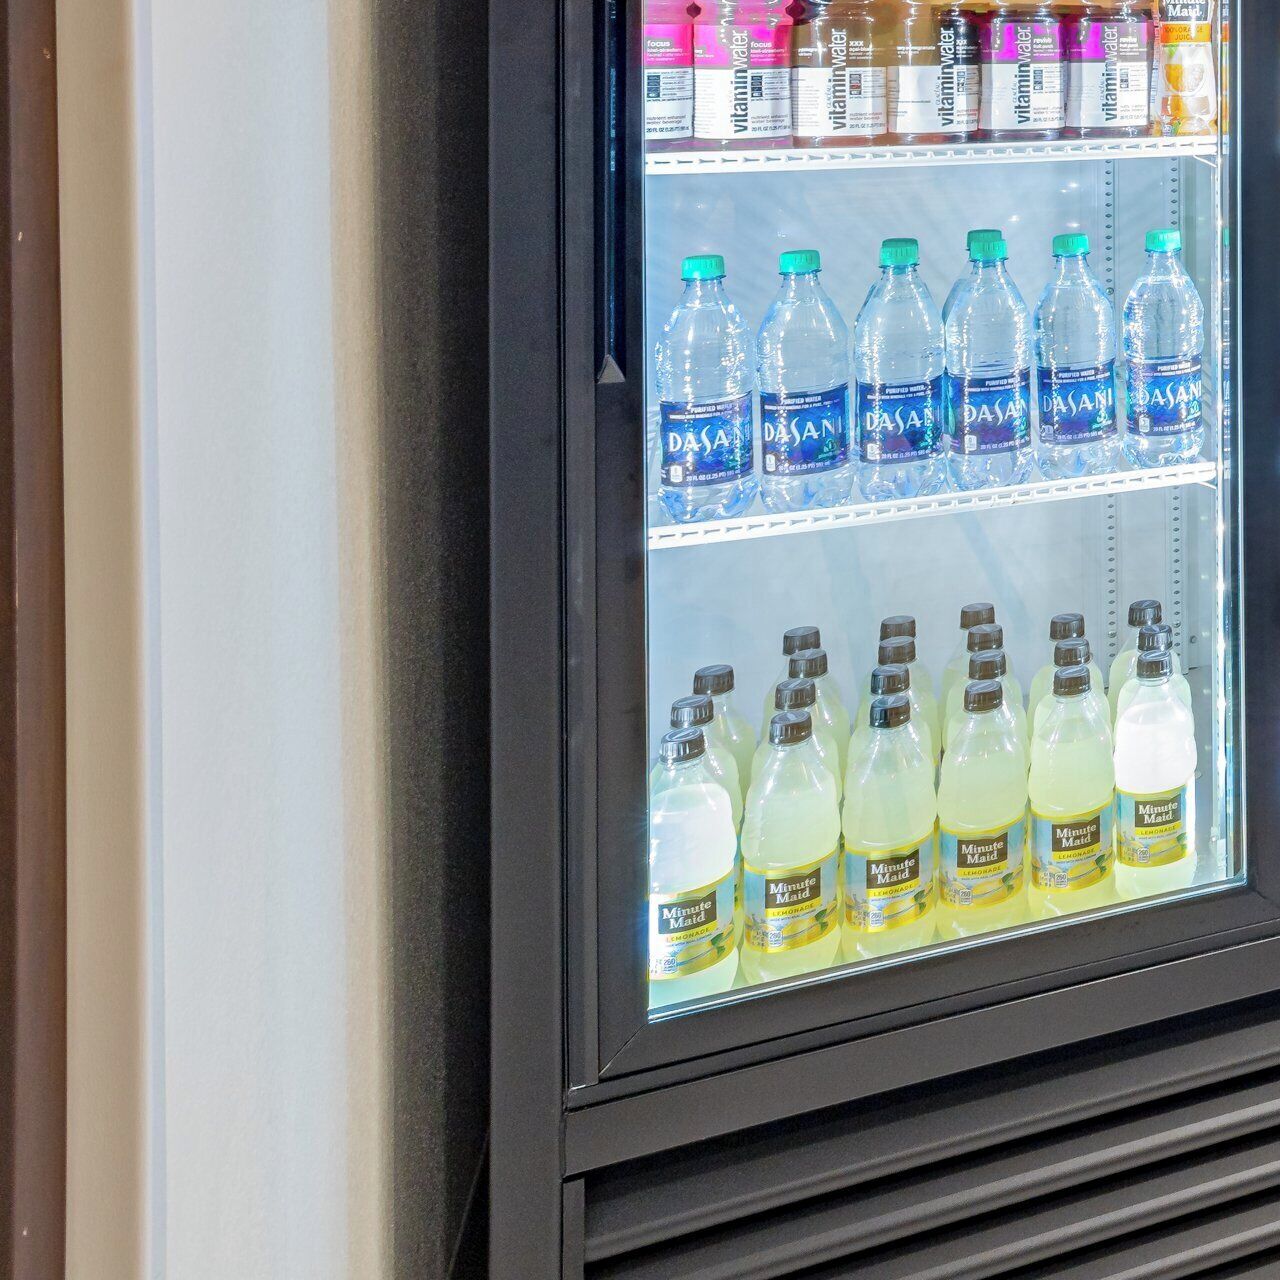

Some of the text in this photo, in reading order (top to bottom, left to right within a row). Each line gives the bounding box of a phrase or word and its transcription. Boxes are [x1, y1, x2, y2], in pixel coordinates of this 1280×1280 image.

[1168, 4, 1201, 17] Maid
[1043, 388, 1112, 416] DASANI
[764, 416, 842, 447] DASANI
[1138, 801, 1178, 816] Minute
[1144, 811, 1174, 824] Maid
[1056, 824, 1096, 840] Minute
[1140, 825, 1176, 836] LEMONADE
[961, 841, 1004, 855] Minute
[1061, 835, 1091, 848] Maid
[967, 852, 998, 865] Maid
[1058, 847, 1095, 860] LEMONADE
[871, 857, 915, 875] Minute
[963, 866, 1001, 877] LEMONADE
[877, 870, 909, 885] Maid
[769, 876, 816, 895] Minute
[873, 884, 914, 897] LEMONADE
[776, 889, 810, 905] Maid
[662, 900, 711, 920] Minute
[772, 903, 814, 917] LEMONADE
[669, 912, 705, 929] Maid
[666, 926, 710, 943] LEMONADE
